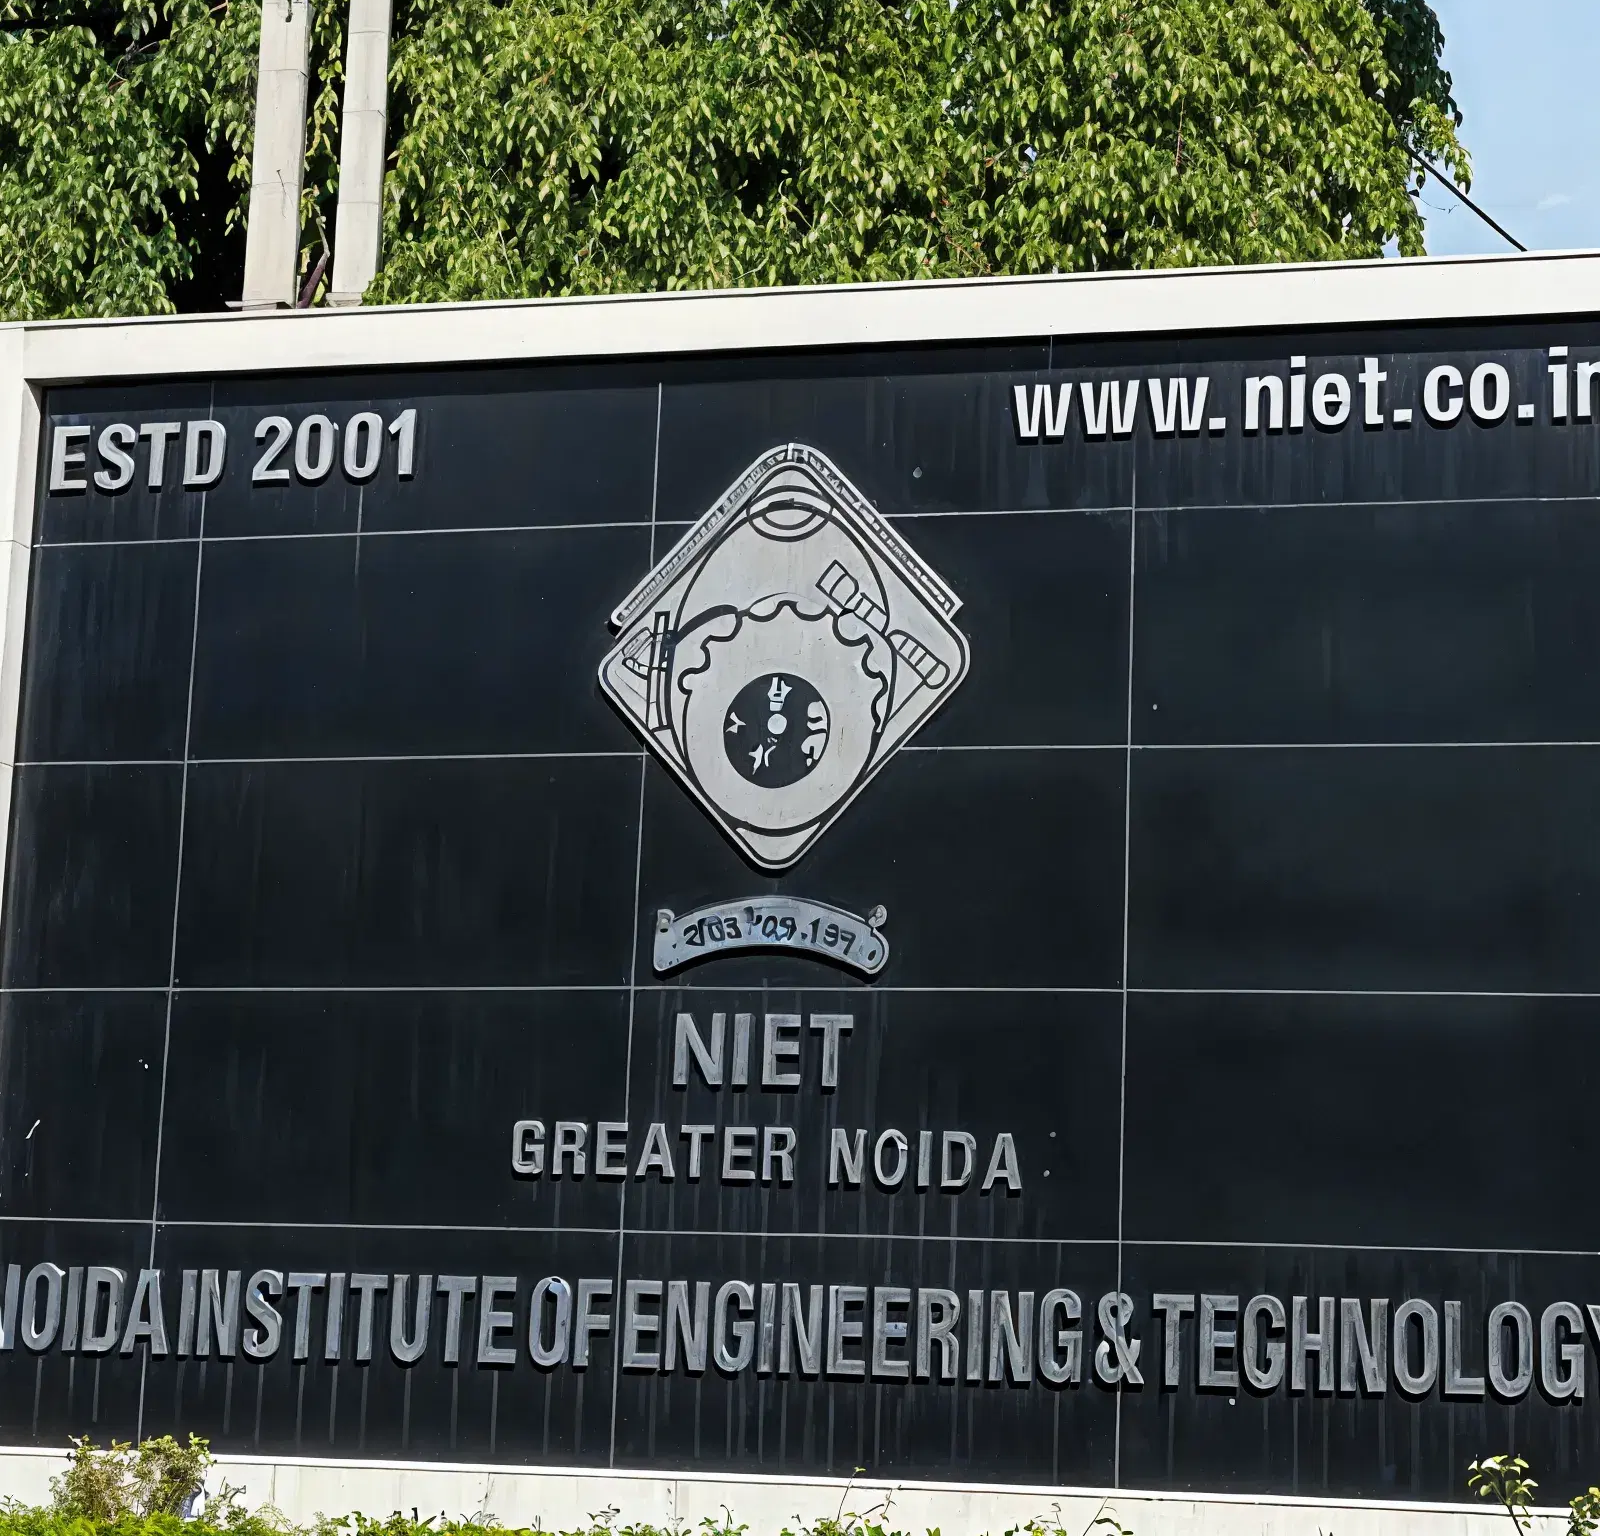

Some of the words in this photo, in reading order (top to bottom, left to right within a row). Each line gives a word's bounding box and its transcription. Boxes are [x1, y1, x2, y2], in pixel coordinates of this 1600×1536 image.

[49, 419, 228, 494] ESTD
[252, 408, 419, 482] 2001
[672, 1012, 854, 1089] NIET
[511, 1119, 797, 1183] GREATER
[828, 1127, 1024, 1192] NOIDA
[177, 1268, 519, 1367] INSTITUTE
[528, 1275, 613, 1369] OF
[621, 1278, 1084, 1385] ENGINEERING
[1094, 1290, 1145, 1385] &
